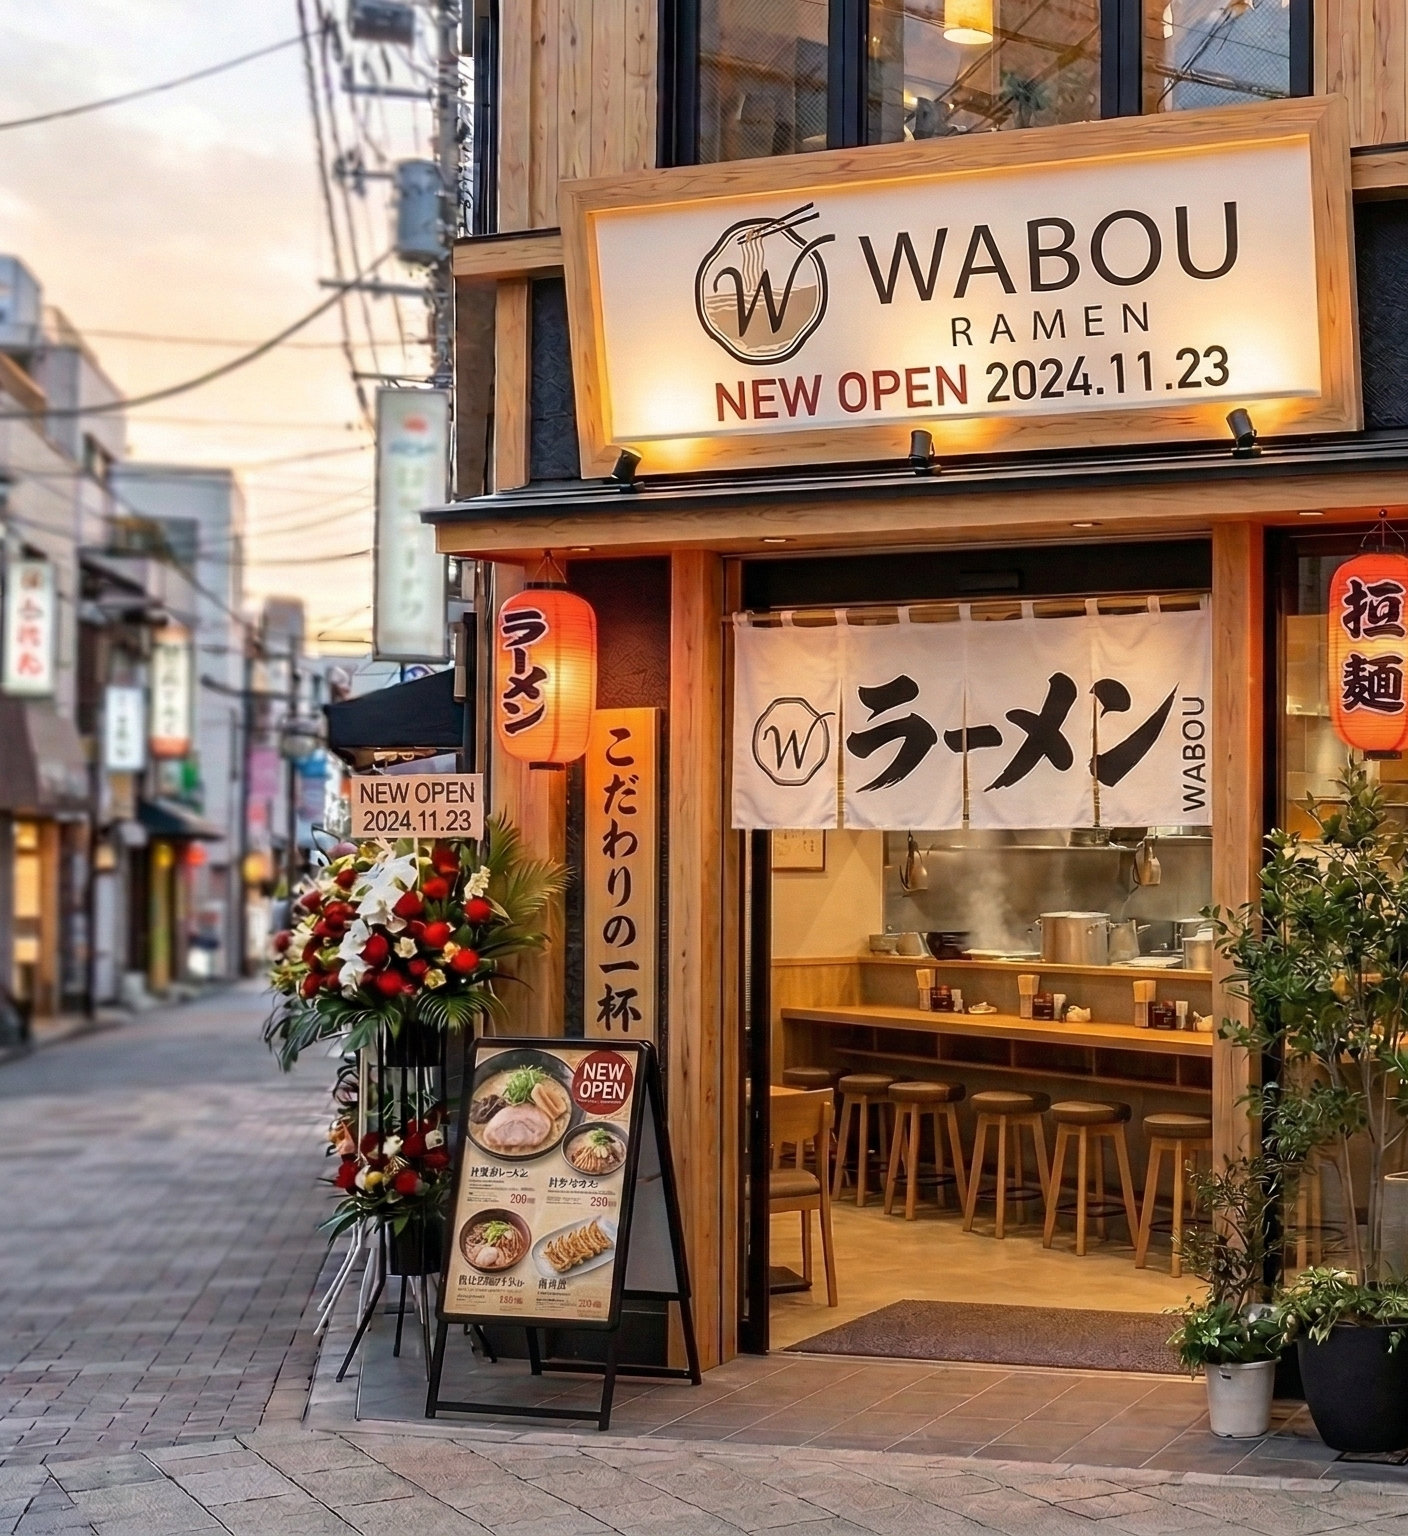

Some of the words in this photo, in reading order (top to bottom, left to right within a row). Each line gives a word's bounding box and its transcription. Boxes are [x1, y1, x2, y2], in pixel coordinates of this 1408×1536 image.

[859, 201, 1239, 304] WABOU
[951, 302, 1150, 347] RAMEN
[715, 374, 821, 422] NEW
[837, 364, 968, 413] OPEN
[986, 345, 1230, 402] 2024.11.23
[502, 610, 548, 735] ラーメン
[846, 672, 1180, 792] ラーメン
[1182, 697, 1206, 812] WABOU
[360, 782, 410, 804] NEW
[415, 782, 475, 804] OPEN
[363, 810, 472, 831] 2024.11.23
[596, 727, 642, 1032] こだわりの一杯
[580, 1081, 625, 1099] OPEN
[583, 1062, 626, 1080] NEW
